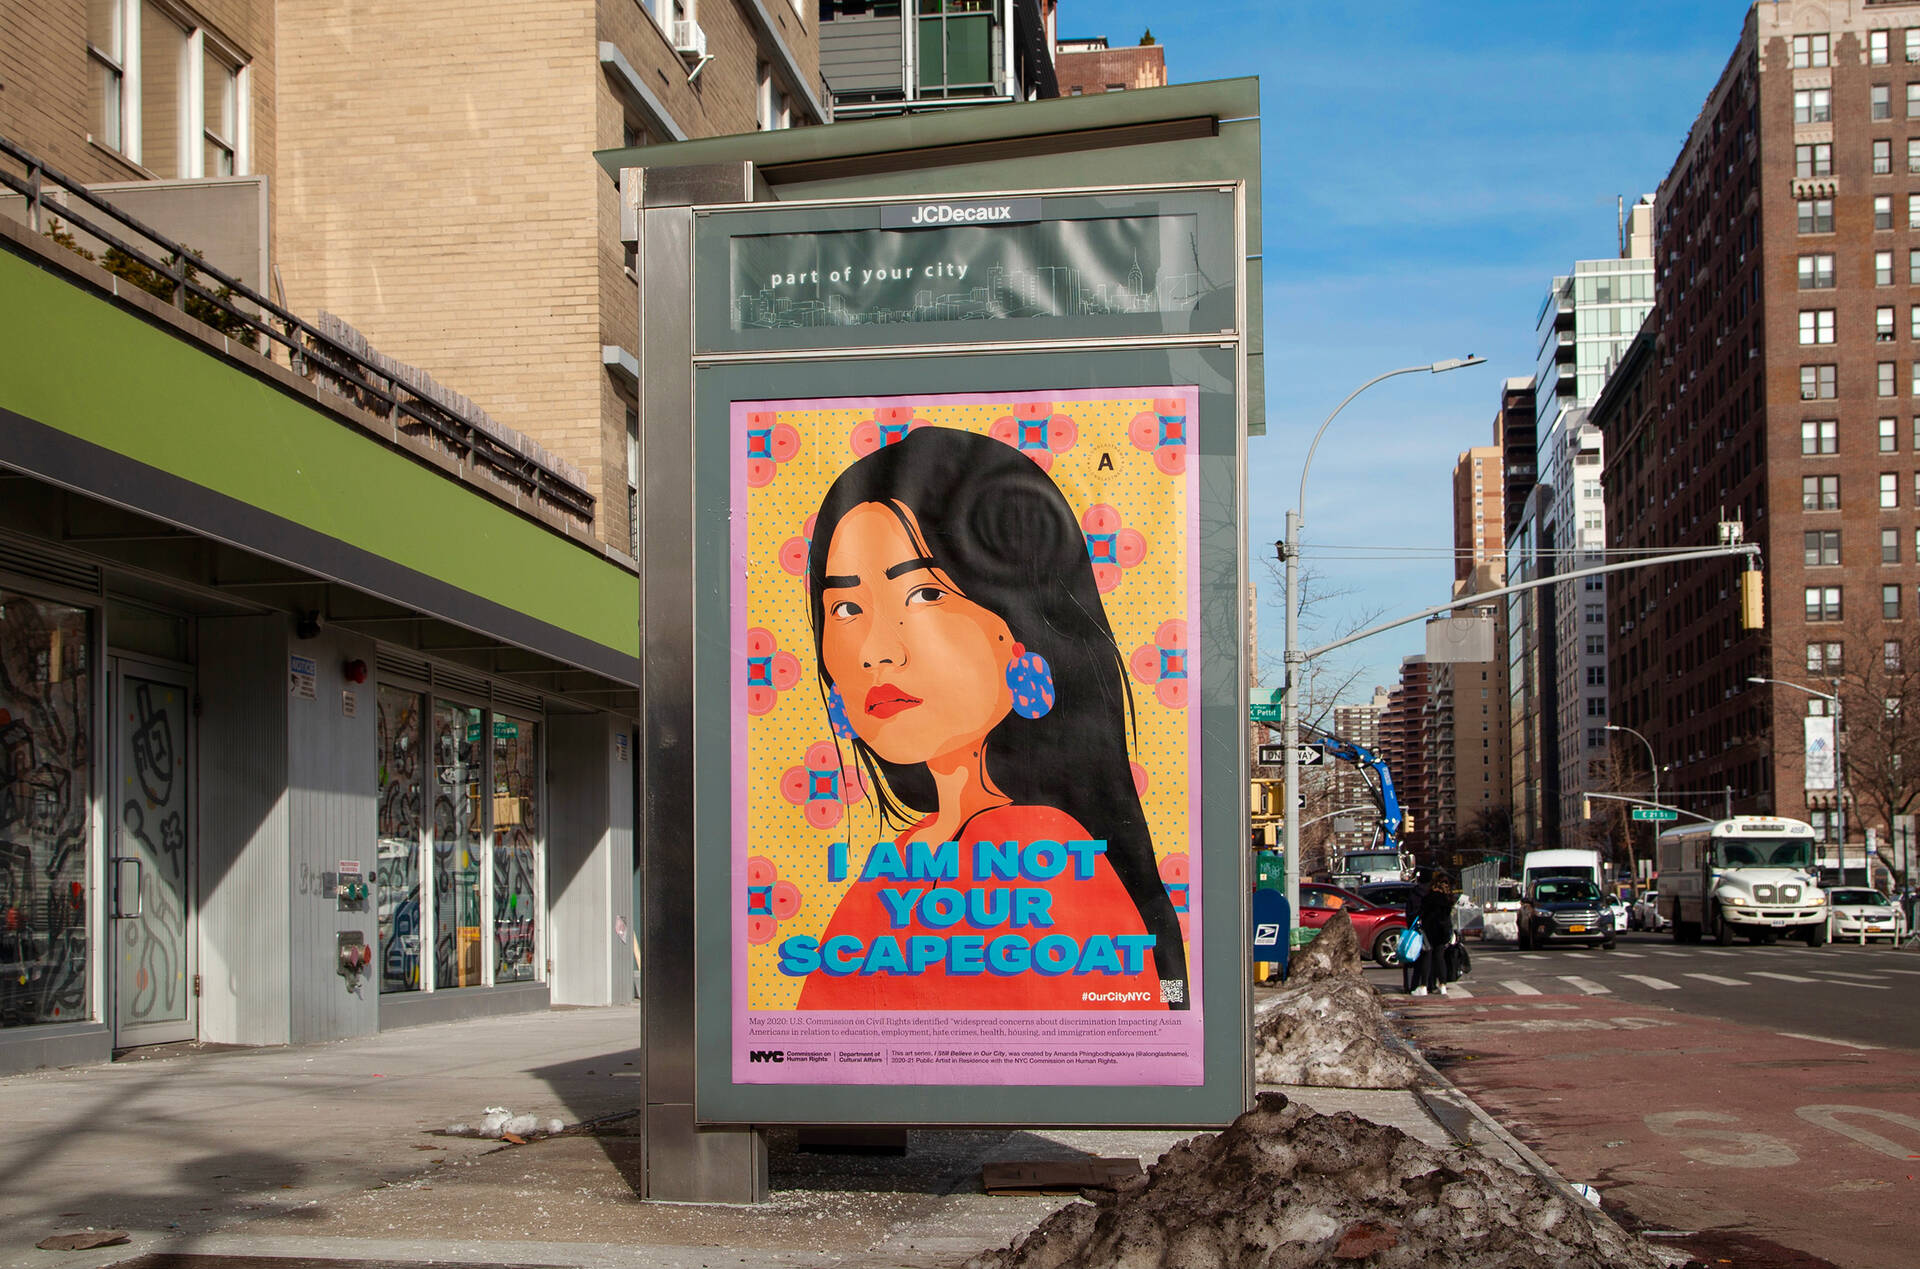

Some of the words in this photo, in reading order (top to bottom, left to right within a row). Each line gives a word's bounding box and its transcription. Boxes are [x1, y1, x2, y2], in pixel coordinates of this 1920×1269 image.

[911, 204, 1011, 224] JCDecaux
[771, 269, 819, 288] part
[830, 265, 852, 283] of
[862, 265, 914, 286] your
[924, 262, 969, 283] city
[1098, 453, 1114, 471] A
[828, 842, 848, 882] I
[860, 841, 960, 882] AM
[971, 839, 1107, 882] NOT
[878, 887, 1054, 930] YOUR
[777, 934, 1157, 977] SCAPEGOAT
[1081, 991, 1151, 1003] #OurCityNYC
[750, 1018, 766, 1026] May
[886, 1018, 912, 1026] Rights
[1058, 1029, 1106, 1038] immigration
[750, 1050, 784, 1063] NYC
